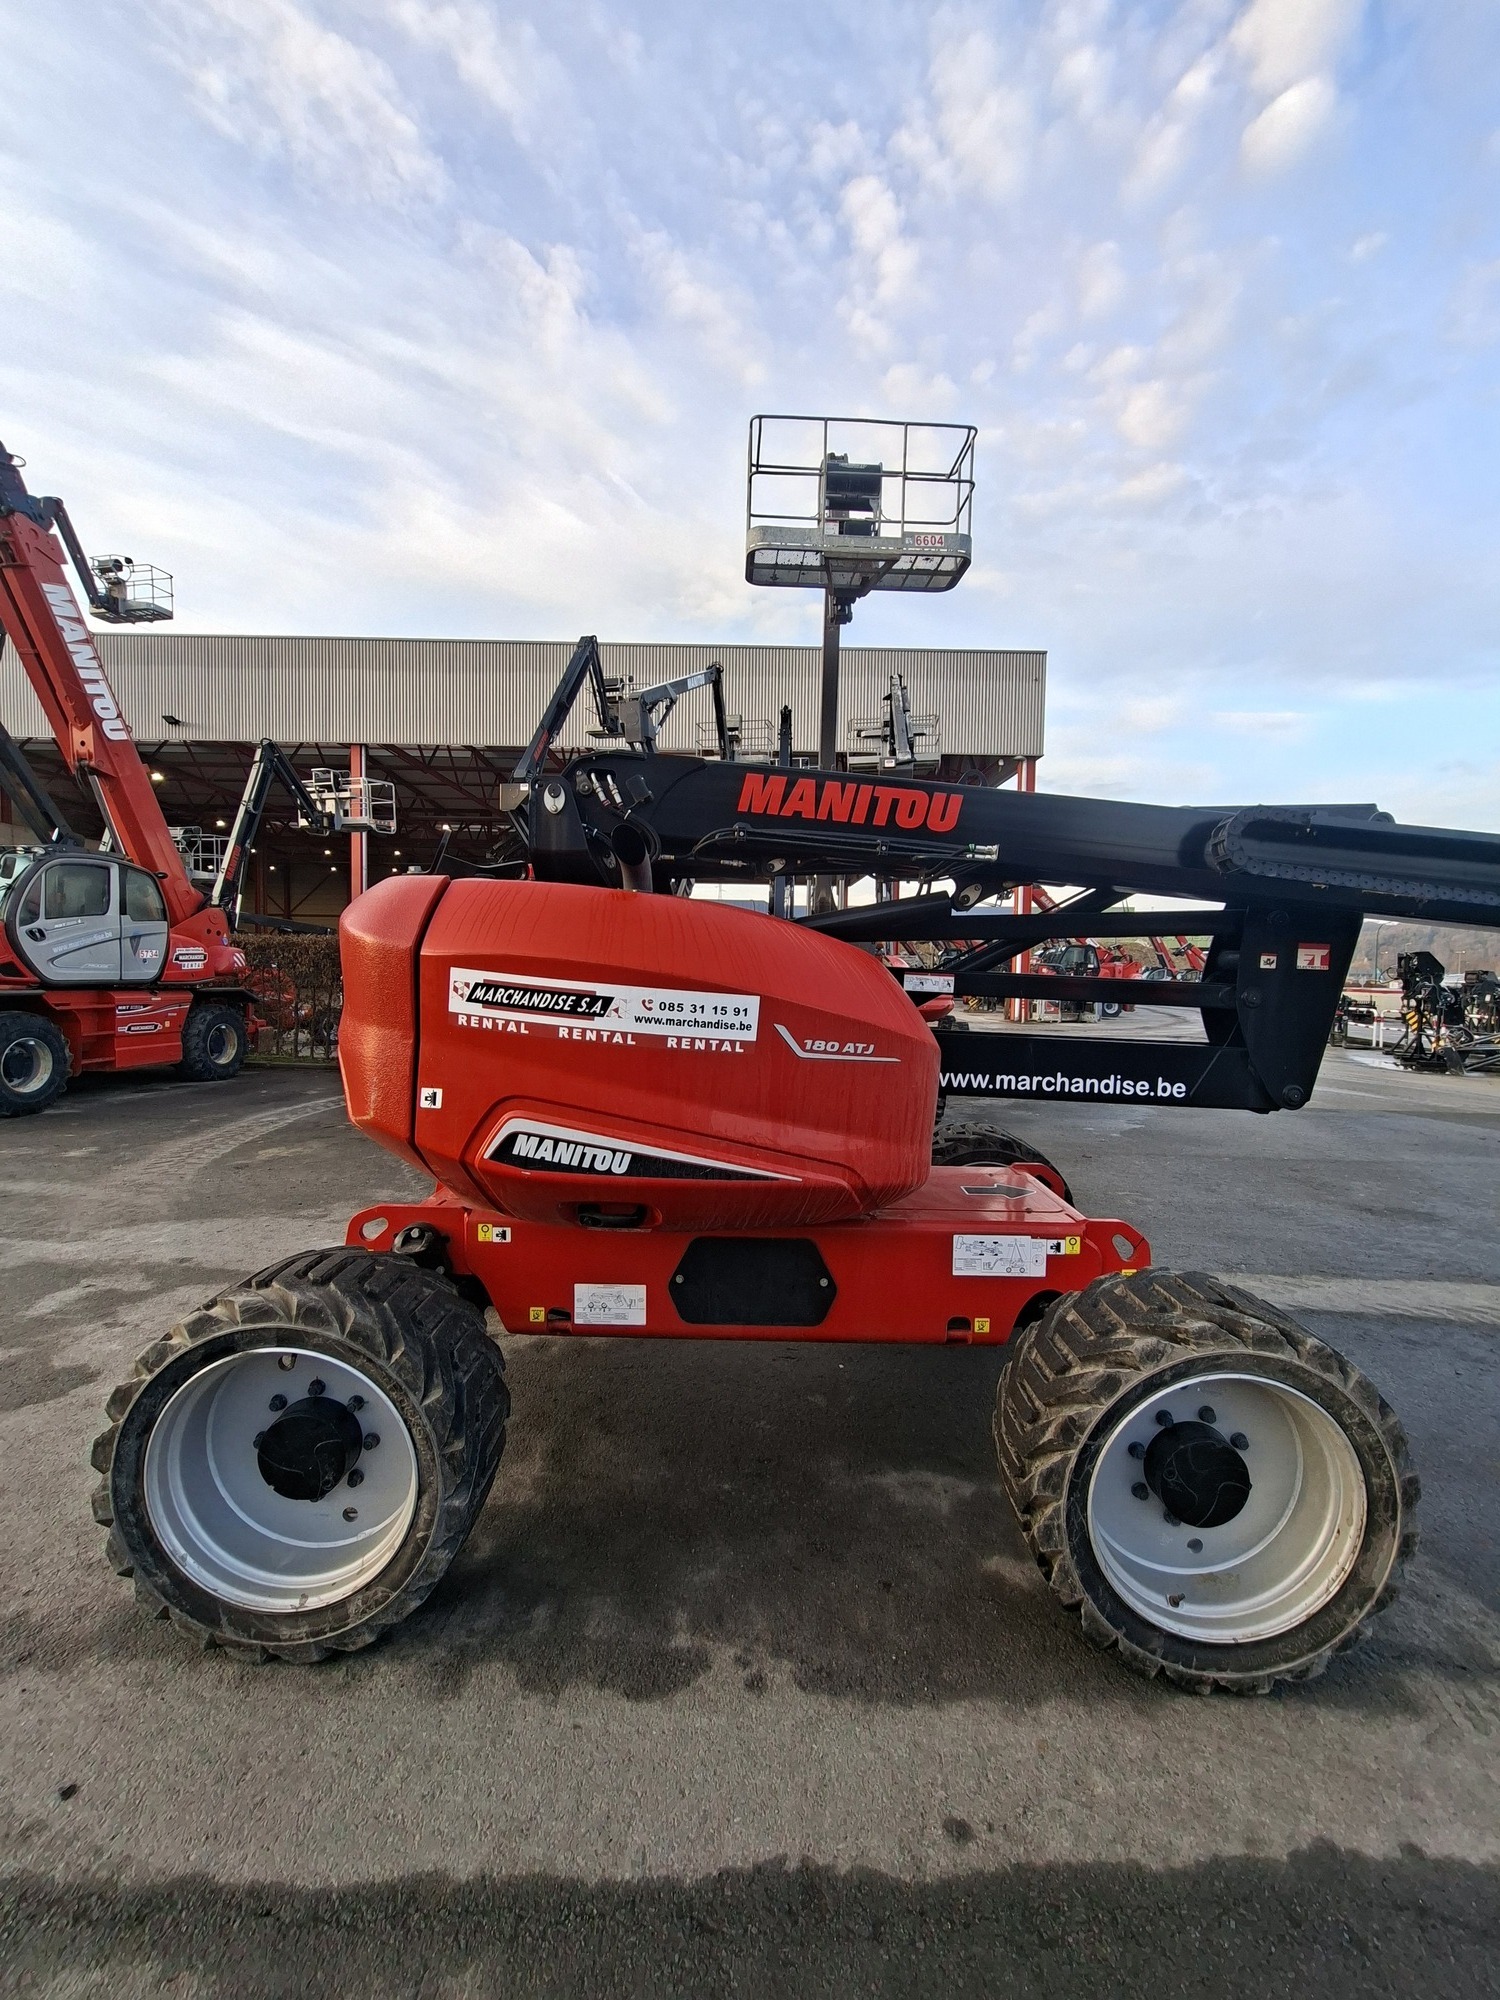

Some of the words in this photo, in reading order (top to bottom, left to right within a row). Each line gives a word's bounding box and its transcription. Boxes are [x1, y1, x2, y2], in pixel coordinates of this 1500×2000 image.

[915, 535, 944, 546] 6604
[41, 583, 128, 741] MANITOU
[736, 772, 964, 833] MANITOU
[471, 985, 575, 1011] MARCHANDISE
[577, 996, 605, 1015] S.A.
[658, 1001, 684, 1013] 085
[689, 1003, 705, 1014] 31
[712, 1005, 728, 1016] 15
[733, 1006, 748, 1017] 91
[458, 1014, 529, 1034] RENTAL
[558, 1026, 636, 1045] RENTAL
[667, 1036, 744, 1053] RENTAL
[634, 1015, 752, 1032] www.marchandise.be
[803, 1039, 840, 1052] 180
[842, 1042, 875, 1055] ATJ
[512, 1133, 632, 1174] MANITOU
